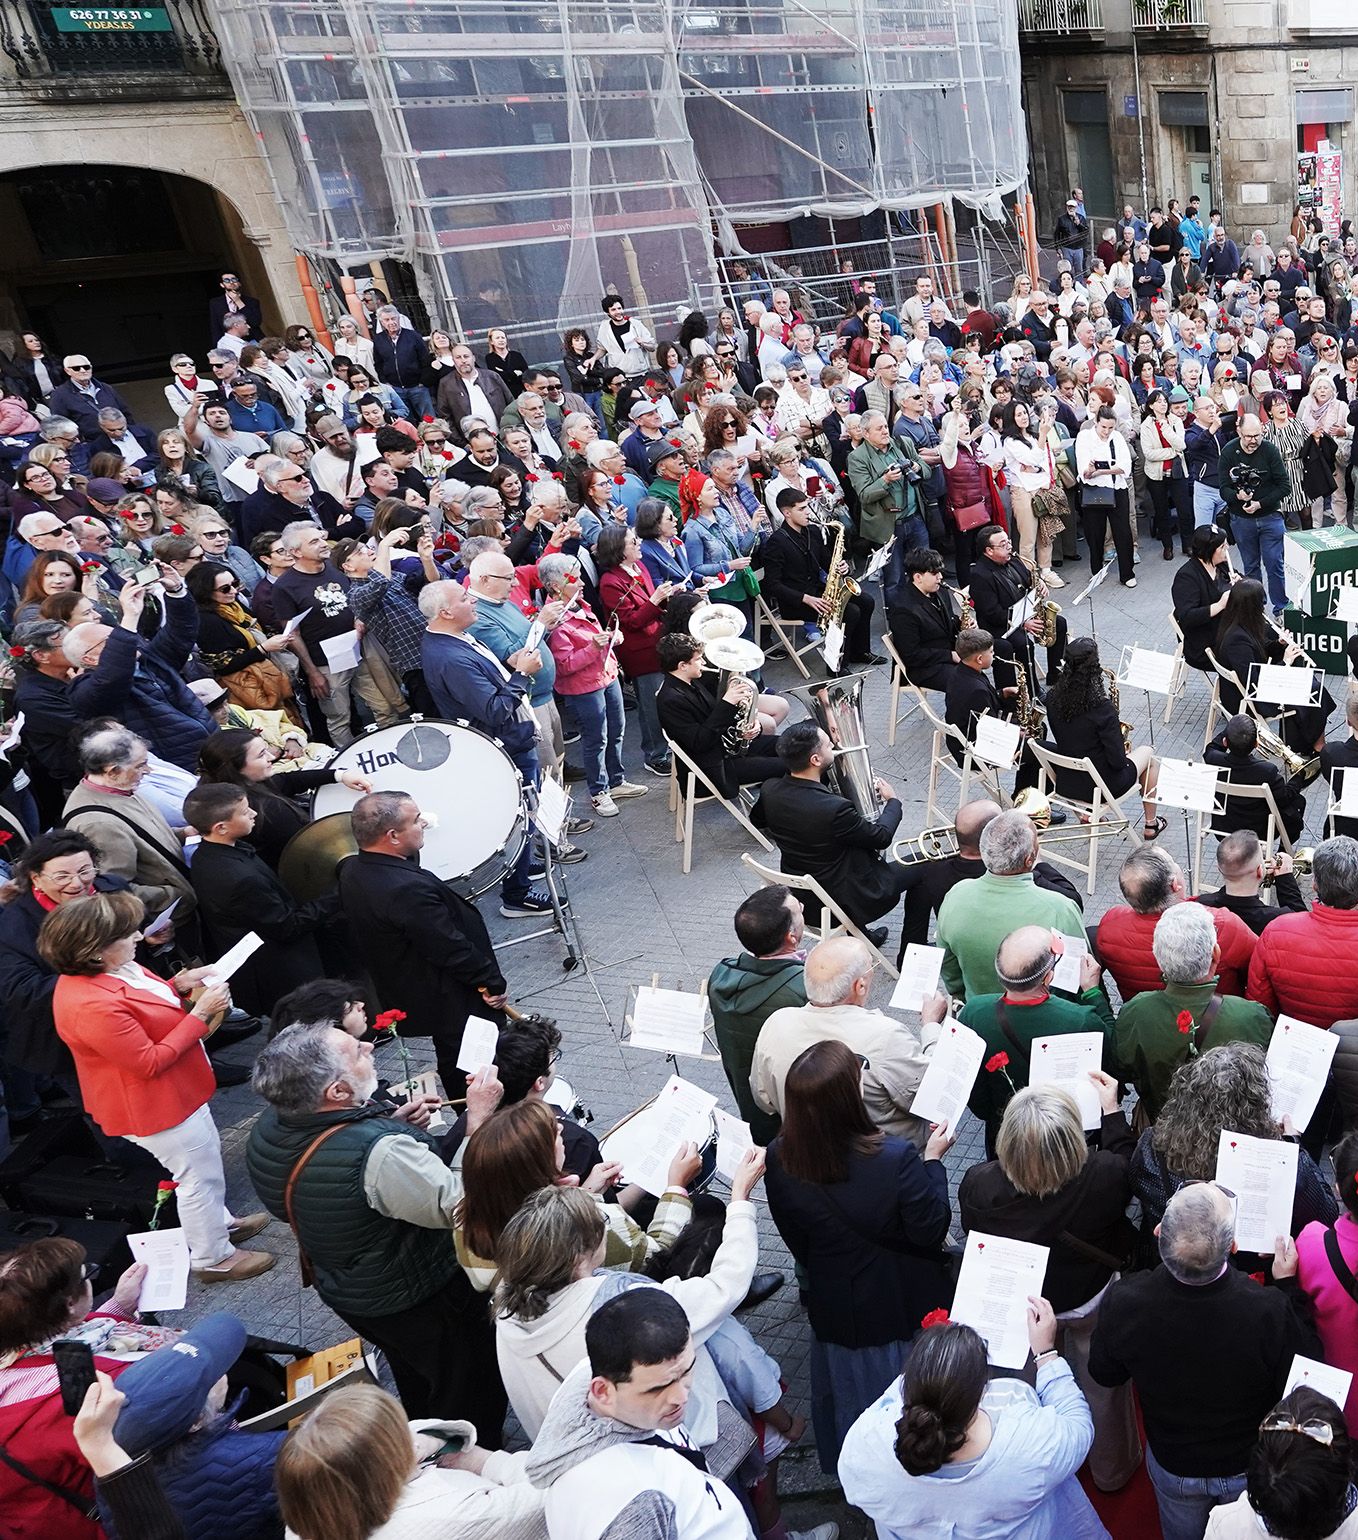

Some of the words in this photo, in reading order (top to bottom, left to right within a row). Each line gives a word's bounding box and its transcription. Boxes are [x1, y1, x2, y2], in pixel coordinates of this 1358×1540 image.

[69, 10, 94, 20] 626
[95, 10, 109, 20] 77
[111, 10, 127, 20] 36
[128, 10, 142, 20] 31
[85, 21, 135, 30] YDEAS.ES
[551, 222, 576, 233] Layh
[356, 748, 402, 775] HON
